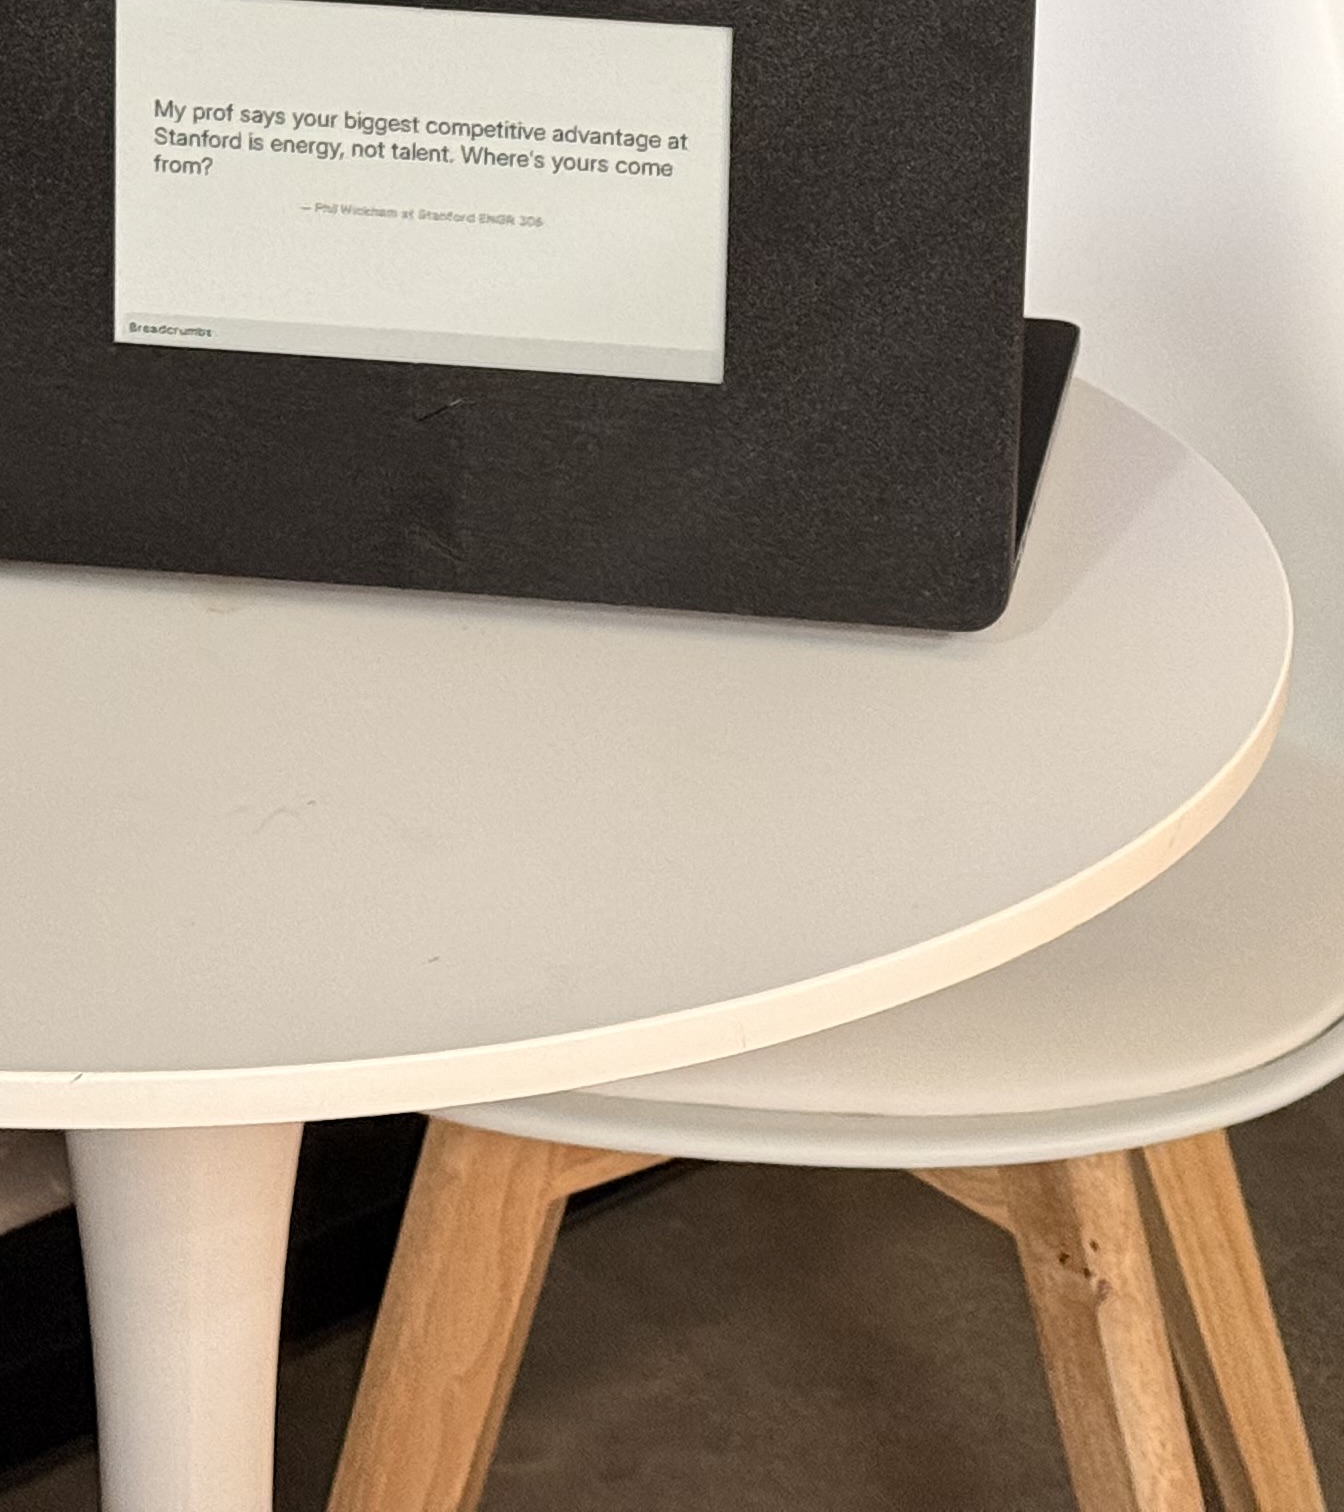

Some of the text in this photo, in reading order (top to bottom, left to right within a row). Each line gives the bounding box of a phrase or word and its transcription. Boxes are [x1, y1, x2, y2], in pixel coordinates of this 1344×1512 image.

[153, 99, 689, 152] My prof says your biggest competitive advantage at
[153, 127, 674, 176] Stanford is energy, not talent. Where's yours come
[152, 154, 215, 175] from?
[314, 203, 337, 214] Phil
[401, 210, 414, 219] at
[418, 209, 476, 223] Stanford
[478, 214, 516, 225] ENGR
[128, 322, 213, 337] Breadcrumbs
